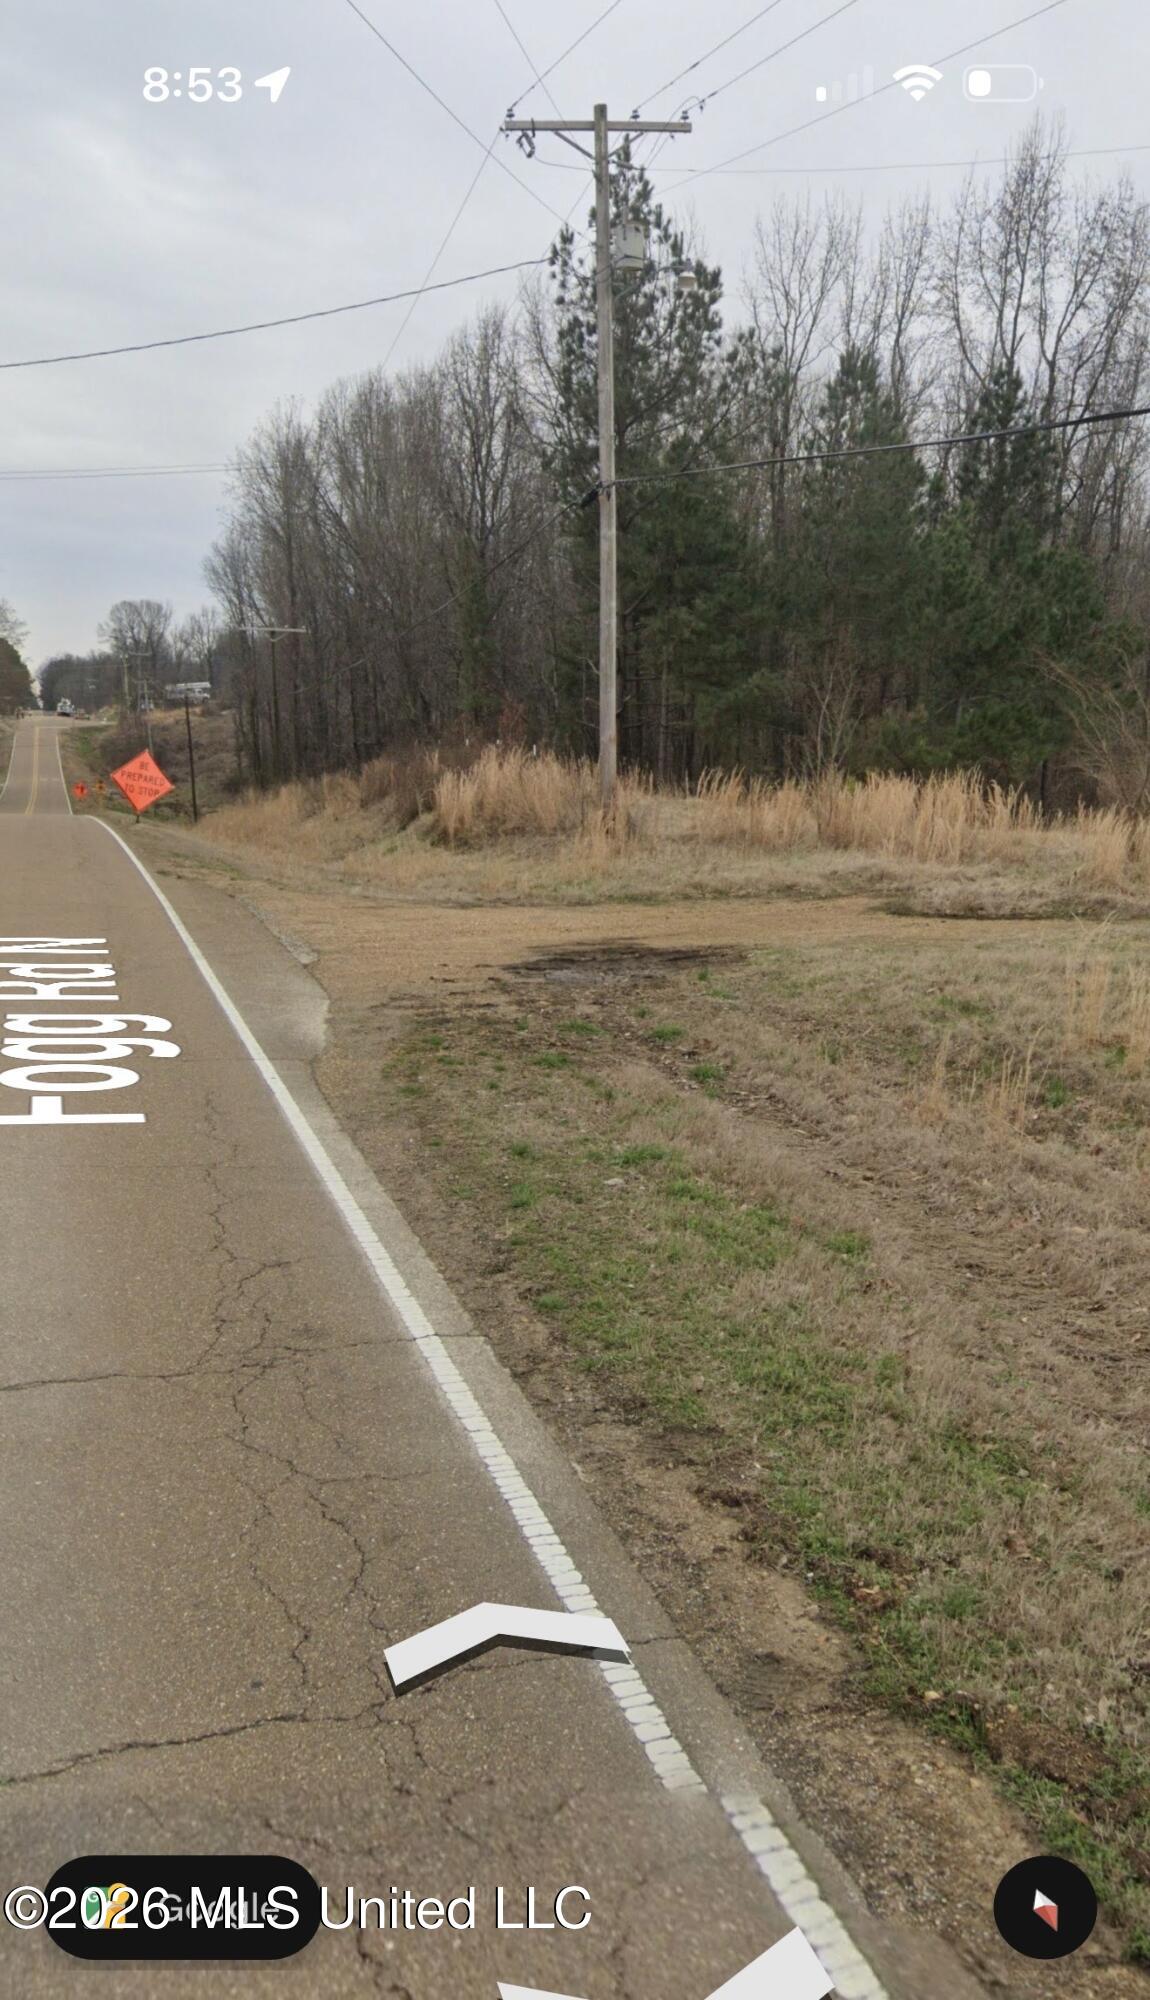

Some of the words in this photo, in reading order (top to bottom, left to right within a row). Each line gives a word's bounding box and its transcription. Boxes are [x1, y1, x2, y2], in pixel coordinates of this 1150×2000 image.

[140, 761, 150, 771] BE
[121, 770, 165, 786] PREPARED
[125, 783, 135, 793] TO
[139, 786, 160, 798] STOP
